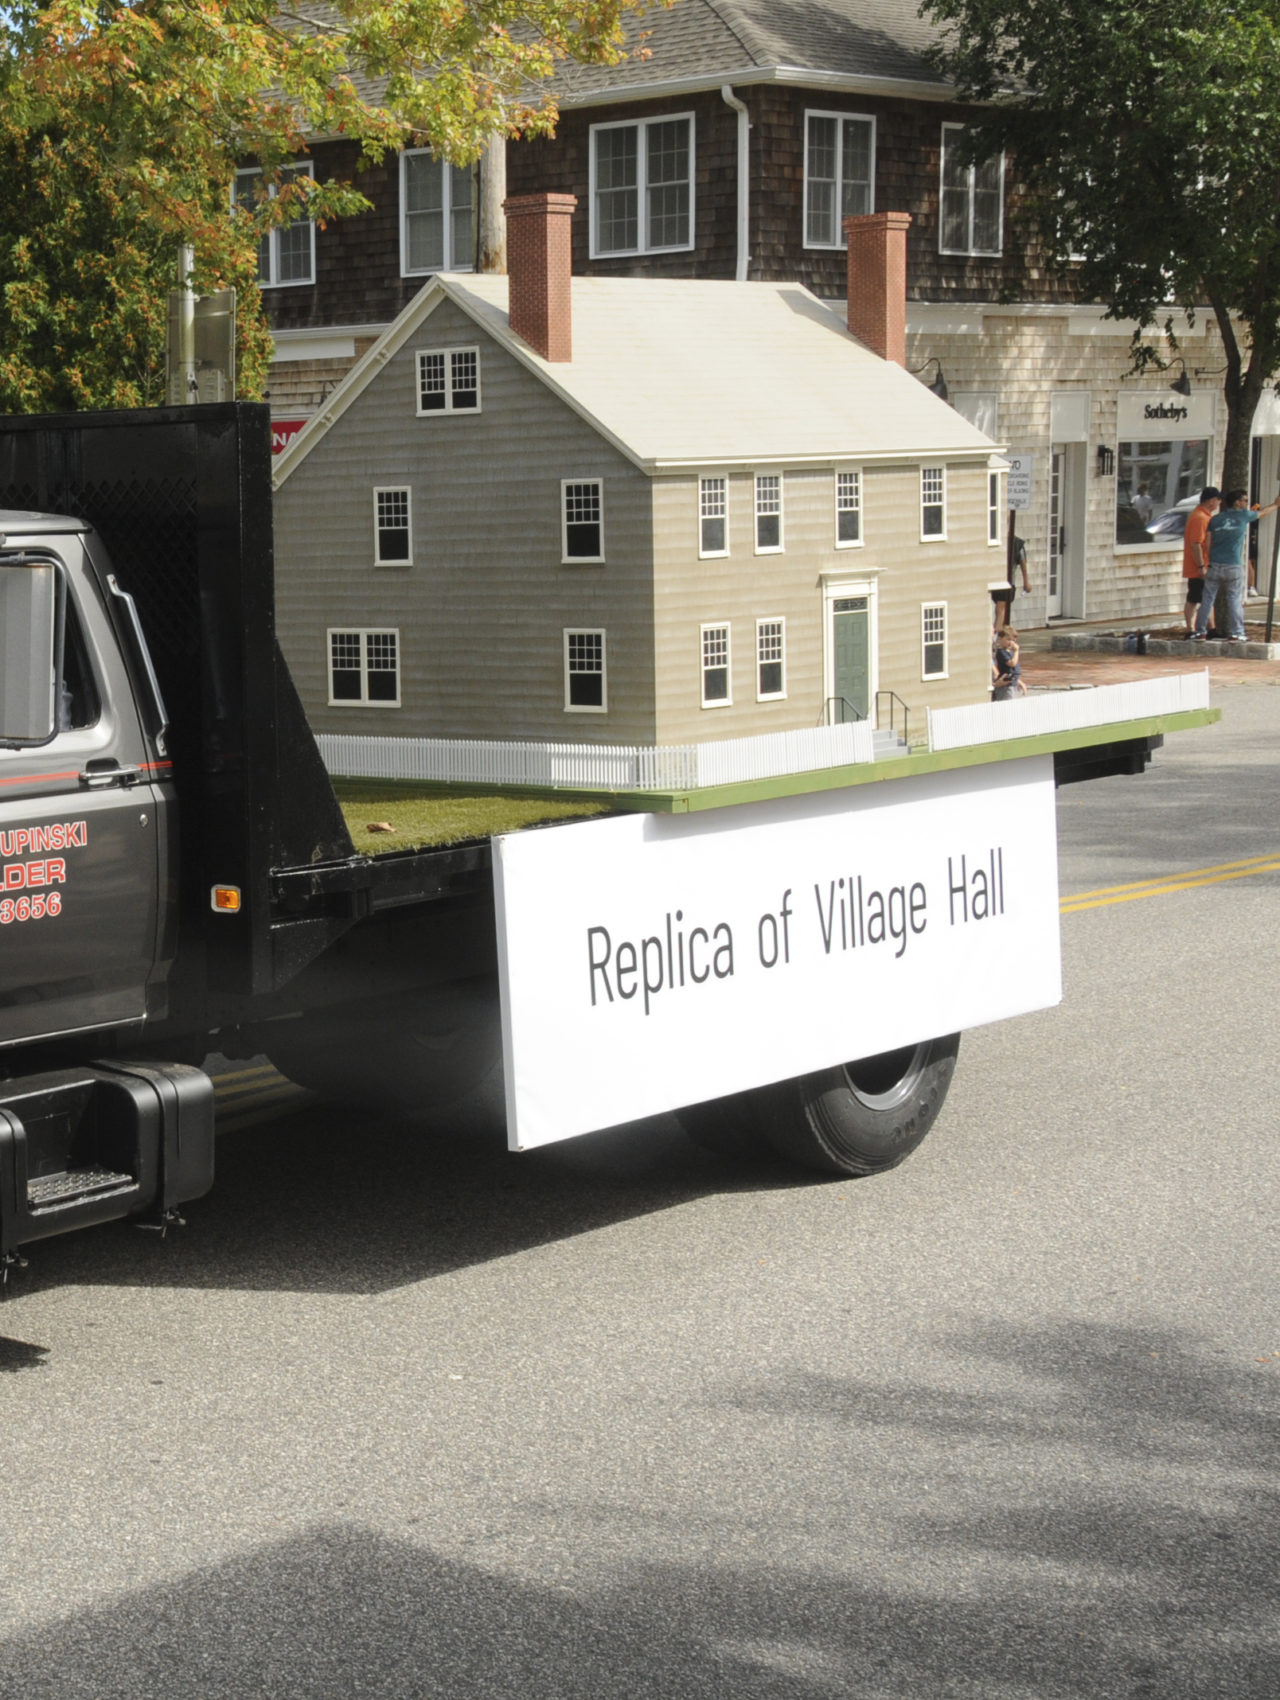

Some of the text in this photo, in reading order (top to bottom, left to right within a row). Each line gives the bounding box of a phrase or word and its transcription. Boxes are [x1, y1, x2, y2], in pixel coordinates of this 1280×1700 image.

[1144, 402, 1188, 423] Sotheby's
[586, 846, 1006, 1017] Replica of Village Hall
